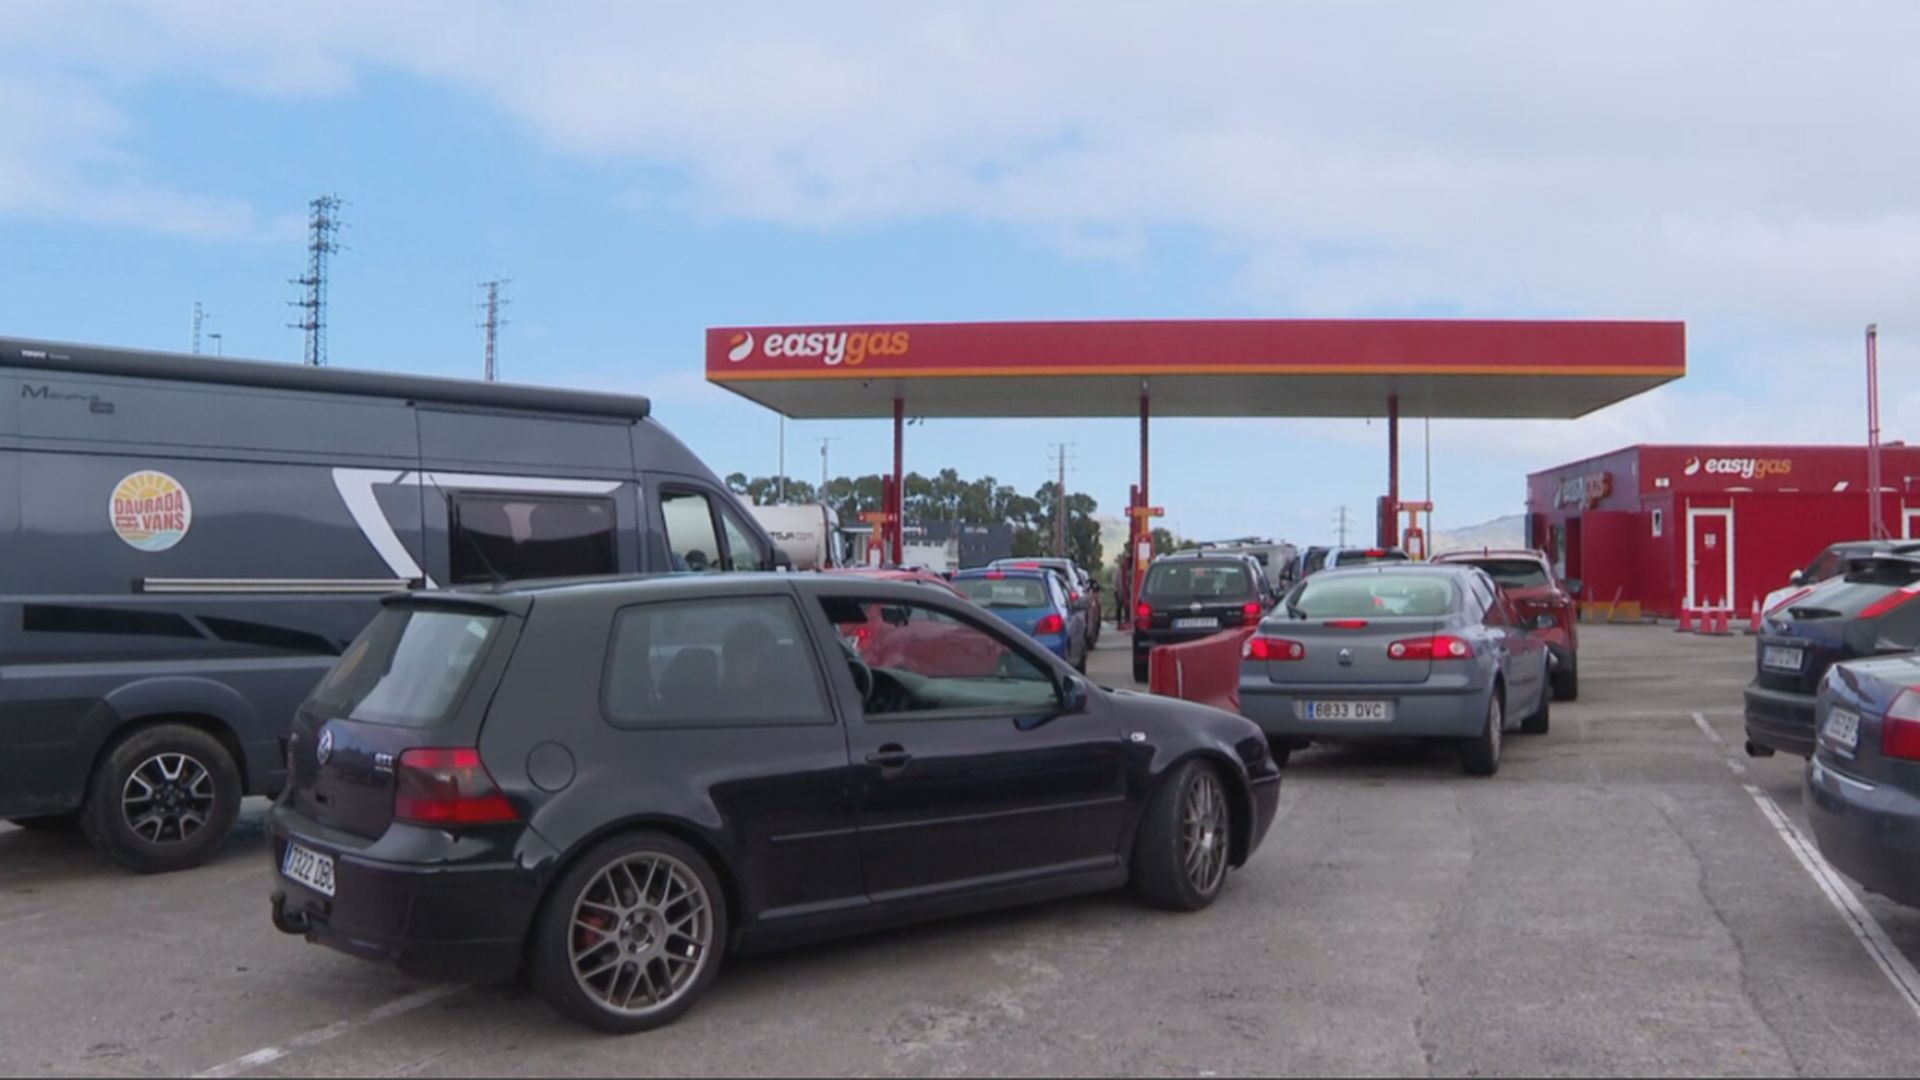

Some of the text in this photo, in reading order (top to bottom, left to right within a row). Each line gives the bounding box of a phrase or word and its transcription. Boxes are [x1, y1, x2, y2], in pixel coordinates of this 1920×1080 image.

[763, 331, 909, 366] easygas
[1705, 458, 1792, 479] easygas
[115, 489, 184, 514] DAURADA
[142, 512, 184, 531] VANS
[1355, 703, 1382, 718] DVC
